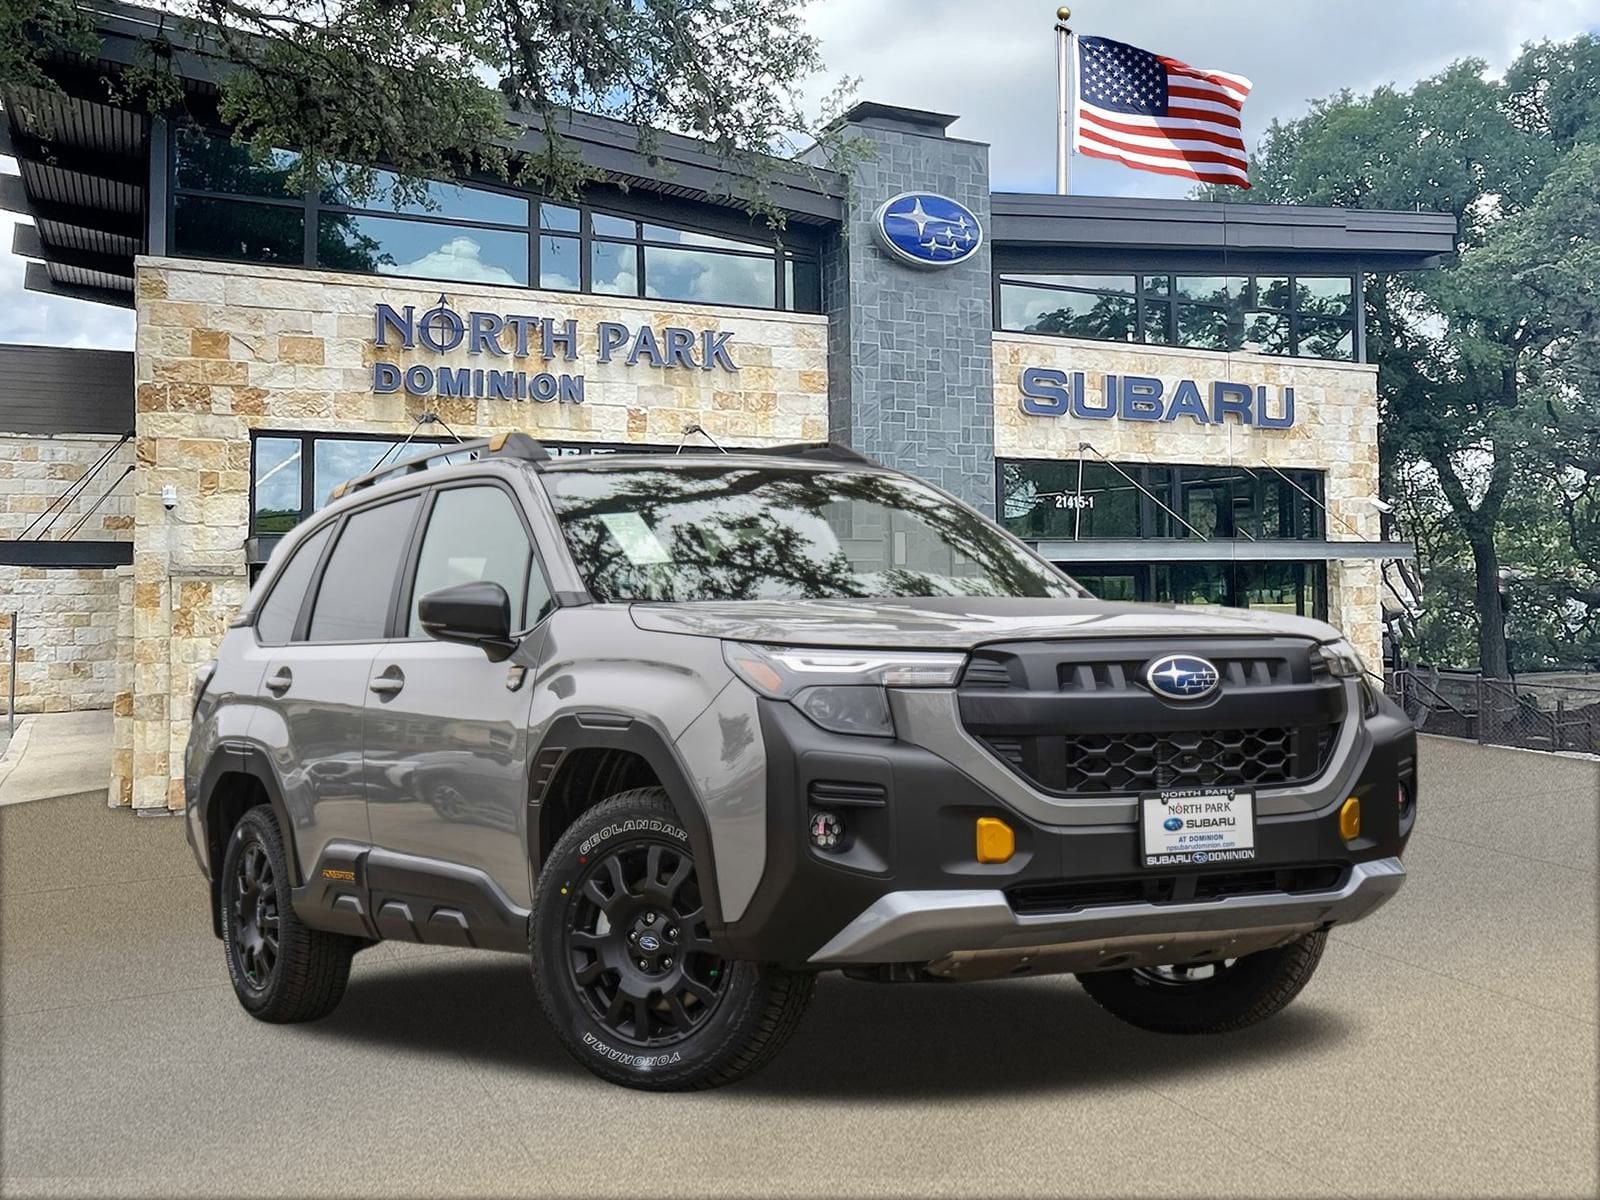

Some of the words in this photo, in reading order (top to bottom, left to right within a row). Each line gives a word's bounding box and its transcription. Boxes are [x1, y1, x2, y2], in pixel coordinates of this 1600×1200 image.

[374, 295, 579, 361] NORTH
[597, 321, 742, 373] PARK
[373, 362, 585, 405] DOMINION
[1018, 367, 1295, 430] SUBARU
[1160, 790, 1201, 799] NORTH
[1205, 788, 1236, 796] PARK
[1168, 802, 1202, 815] NORTH
[1205, 802, 1232, 813] PARK
[1186, 817, 1236, 829] SUBARU
[579, 819, 688, 855] GEOLANDAR
[1178, 836, 1187, 844] AT
[1189, 834, 1224, 843] DOMINION
[1146, 855, 1192, 866] SUBARU
[1208, 850, 1256, 861] DOMINION
[583, 1032, 681, 1067] YOKOHAMA
